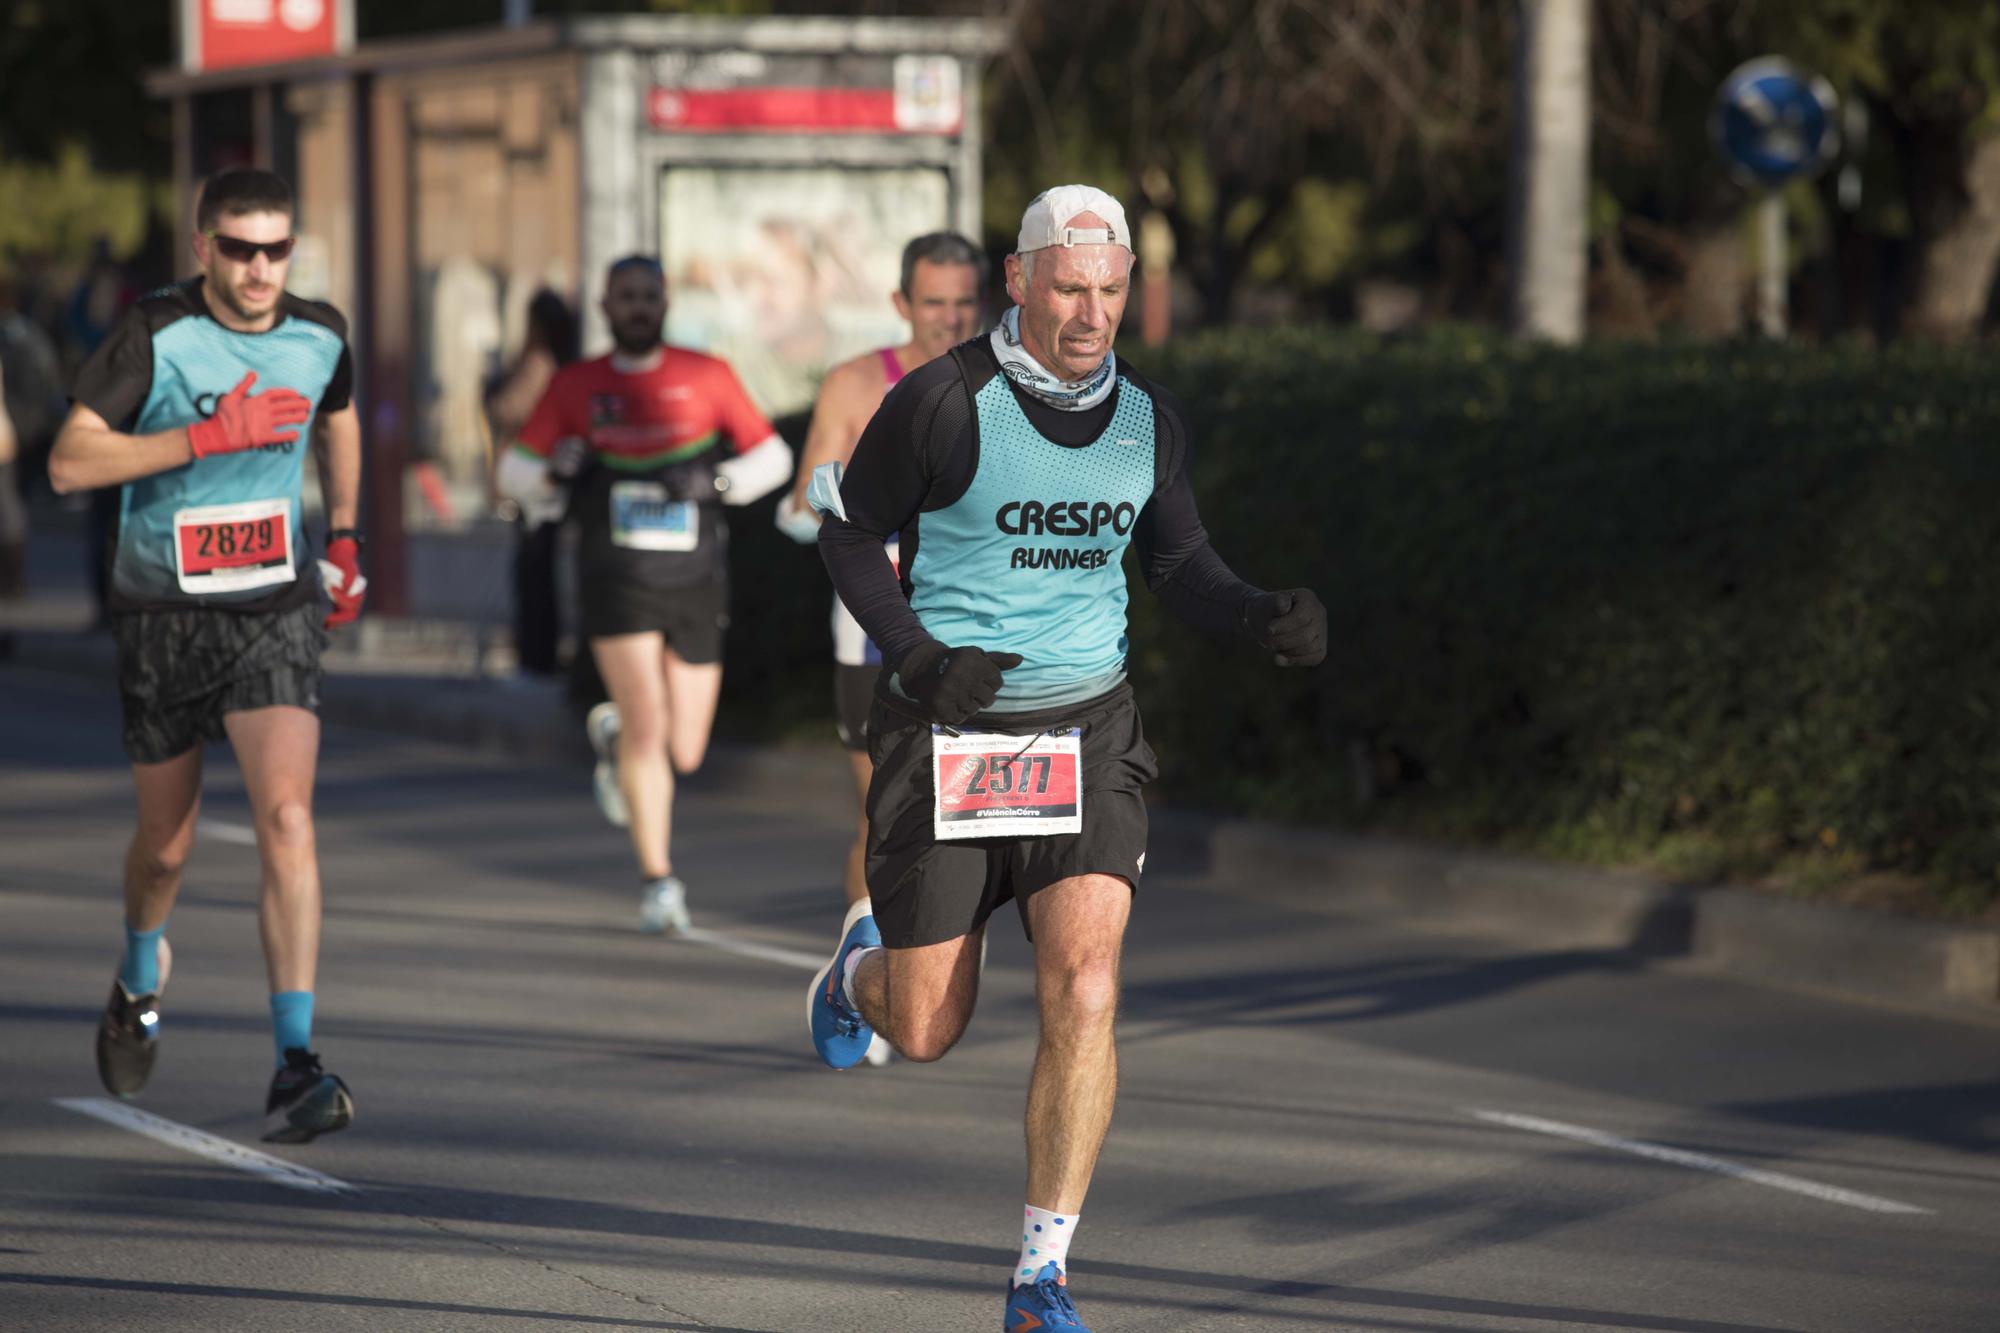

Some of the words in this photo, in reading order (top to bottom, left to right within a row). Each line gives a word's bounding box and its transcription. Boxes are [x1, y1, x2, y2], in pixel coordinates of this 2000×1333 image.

[196, 518, 273, 557] 2829
[995, 500, 1136, 537] CRESPO
[965, 755, 1052, 795] 2577
